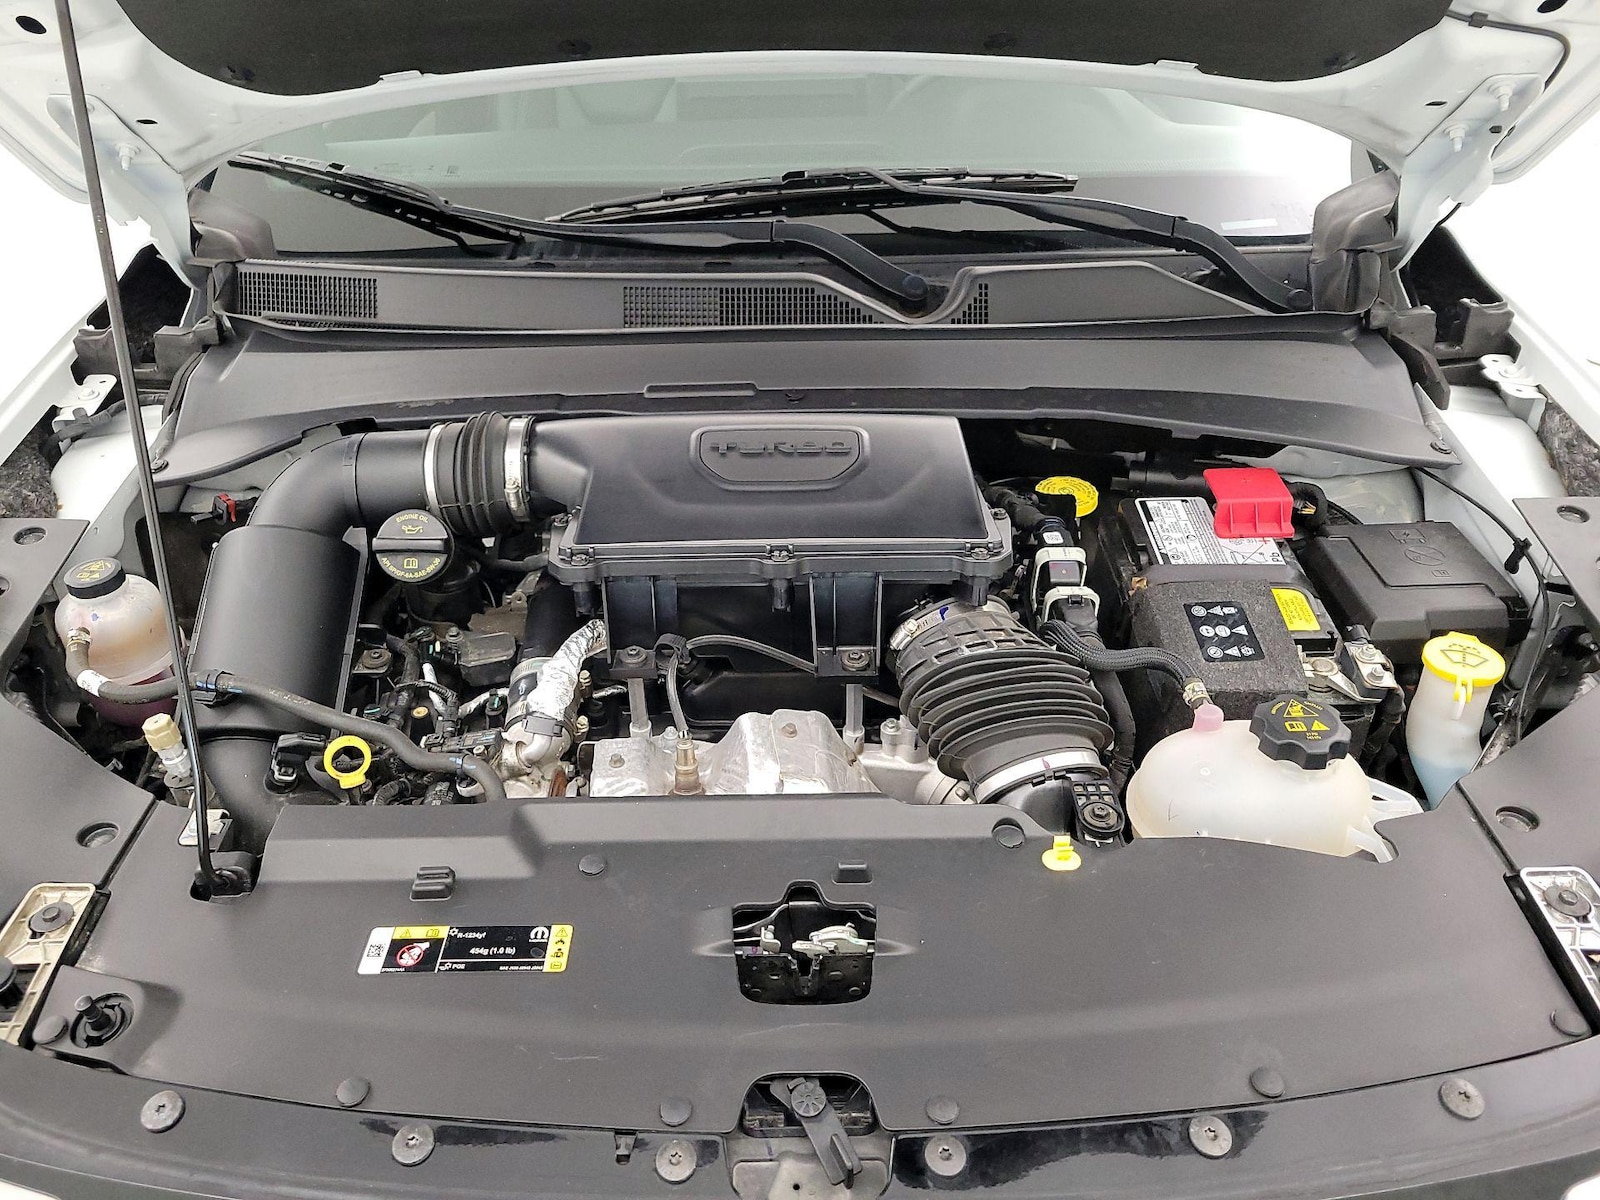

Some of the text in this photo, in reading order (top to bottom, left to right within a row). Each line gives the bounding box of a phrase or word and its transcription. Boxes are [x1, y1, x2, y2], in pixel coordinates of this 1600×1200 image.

[709, 441, 851, 455] TURBO
[396, 513, 429, 523] ENGINE OIL
[381, 557, 391, 568] API
[469, 946, 488, 956] 454g
[505, 946, 516, 955] lb)
